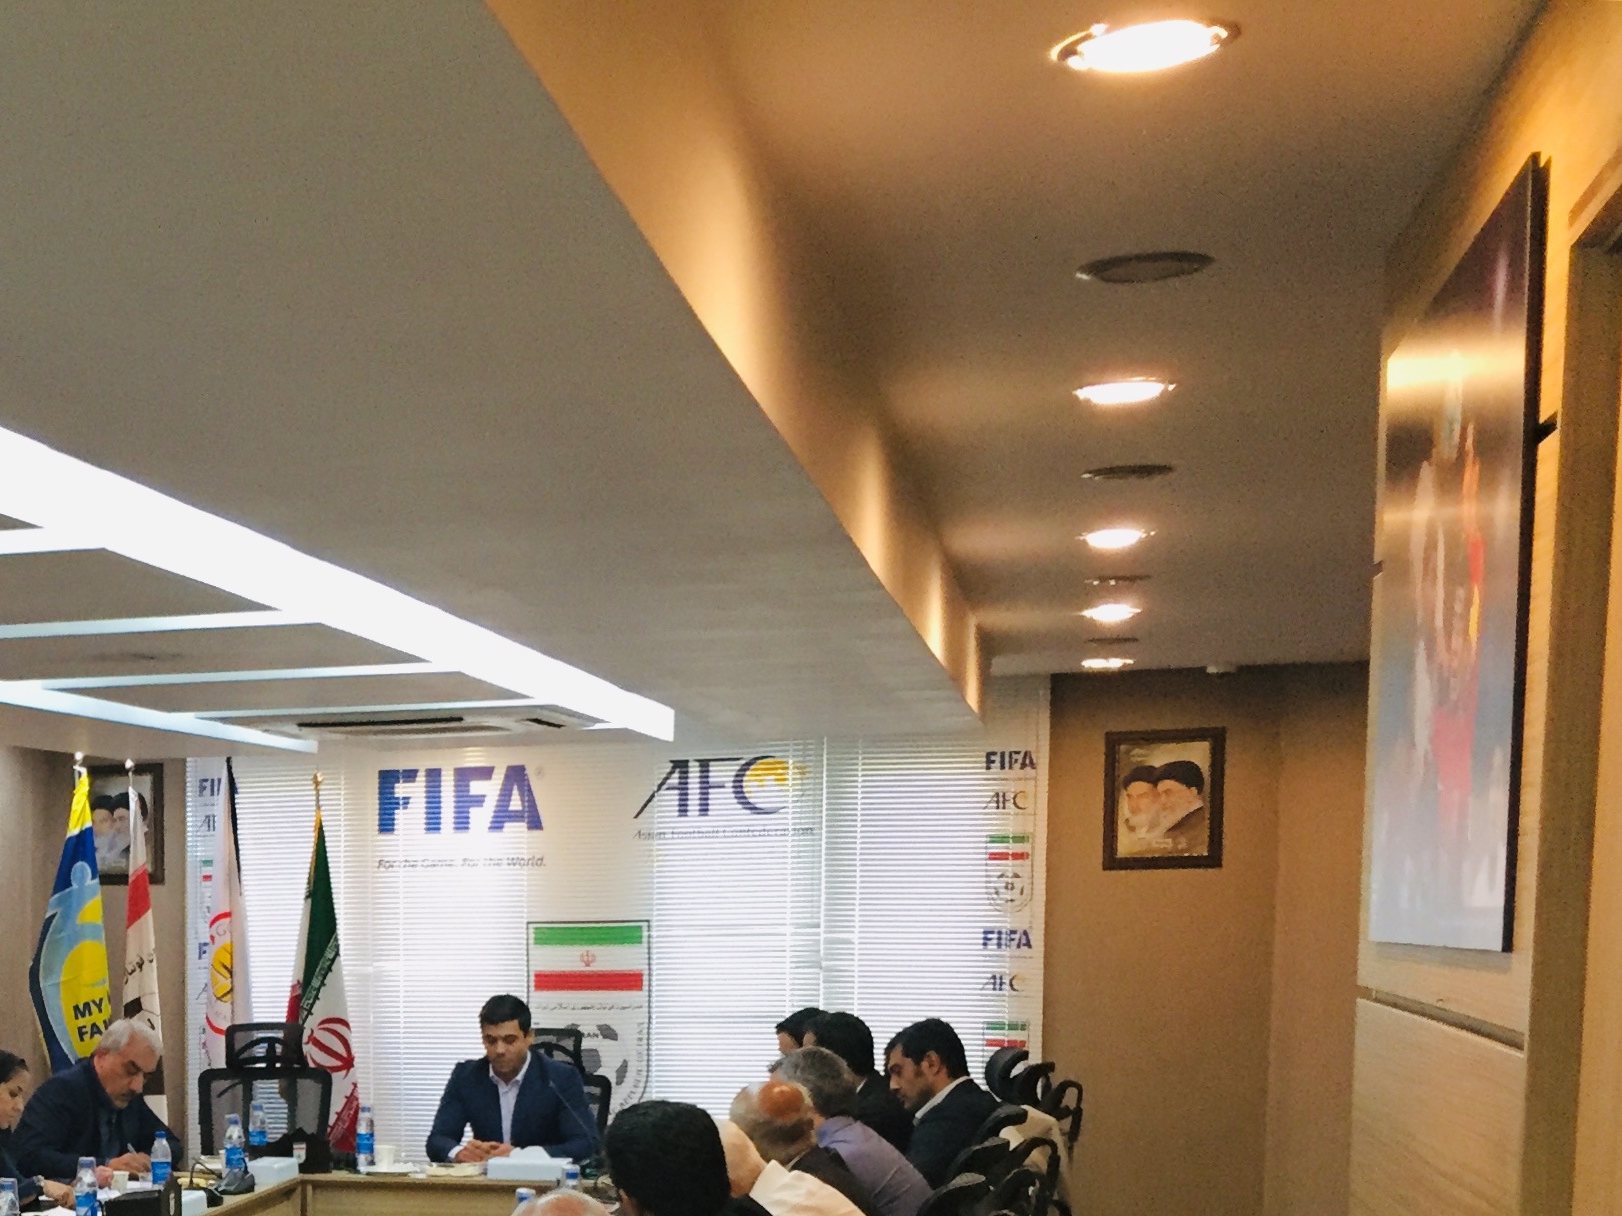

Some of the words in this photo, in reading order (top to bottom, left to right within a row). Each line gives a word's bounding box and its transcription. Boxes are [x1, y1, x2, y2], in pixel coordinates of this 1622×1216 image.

[985, 750, 1037, 771] FIFA
[634, 755, 790, 819] AFC
[377, 764, 544, 834] FIFA
[982, 790, 1030, 811] AFC
[506, 855, 546, 868] World.
[982, 929, 1033, 950] FIFA
[73, 997, 104, 1020] MY
